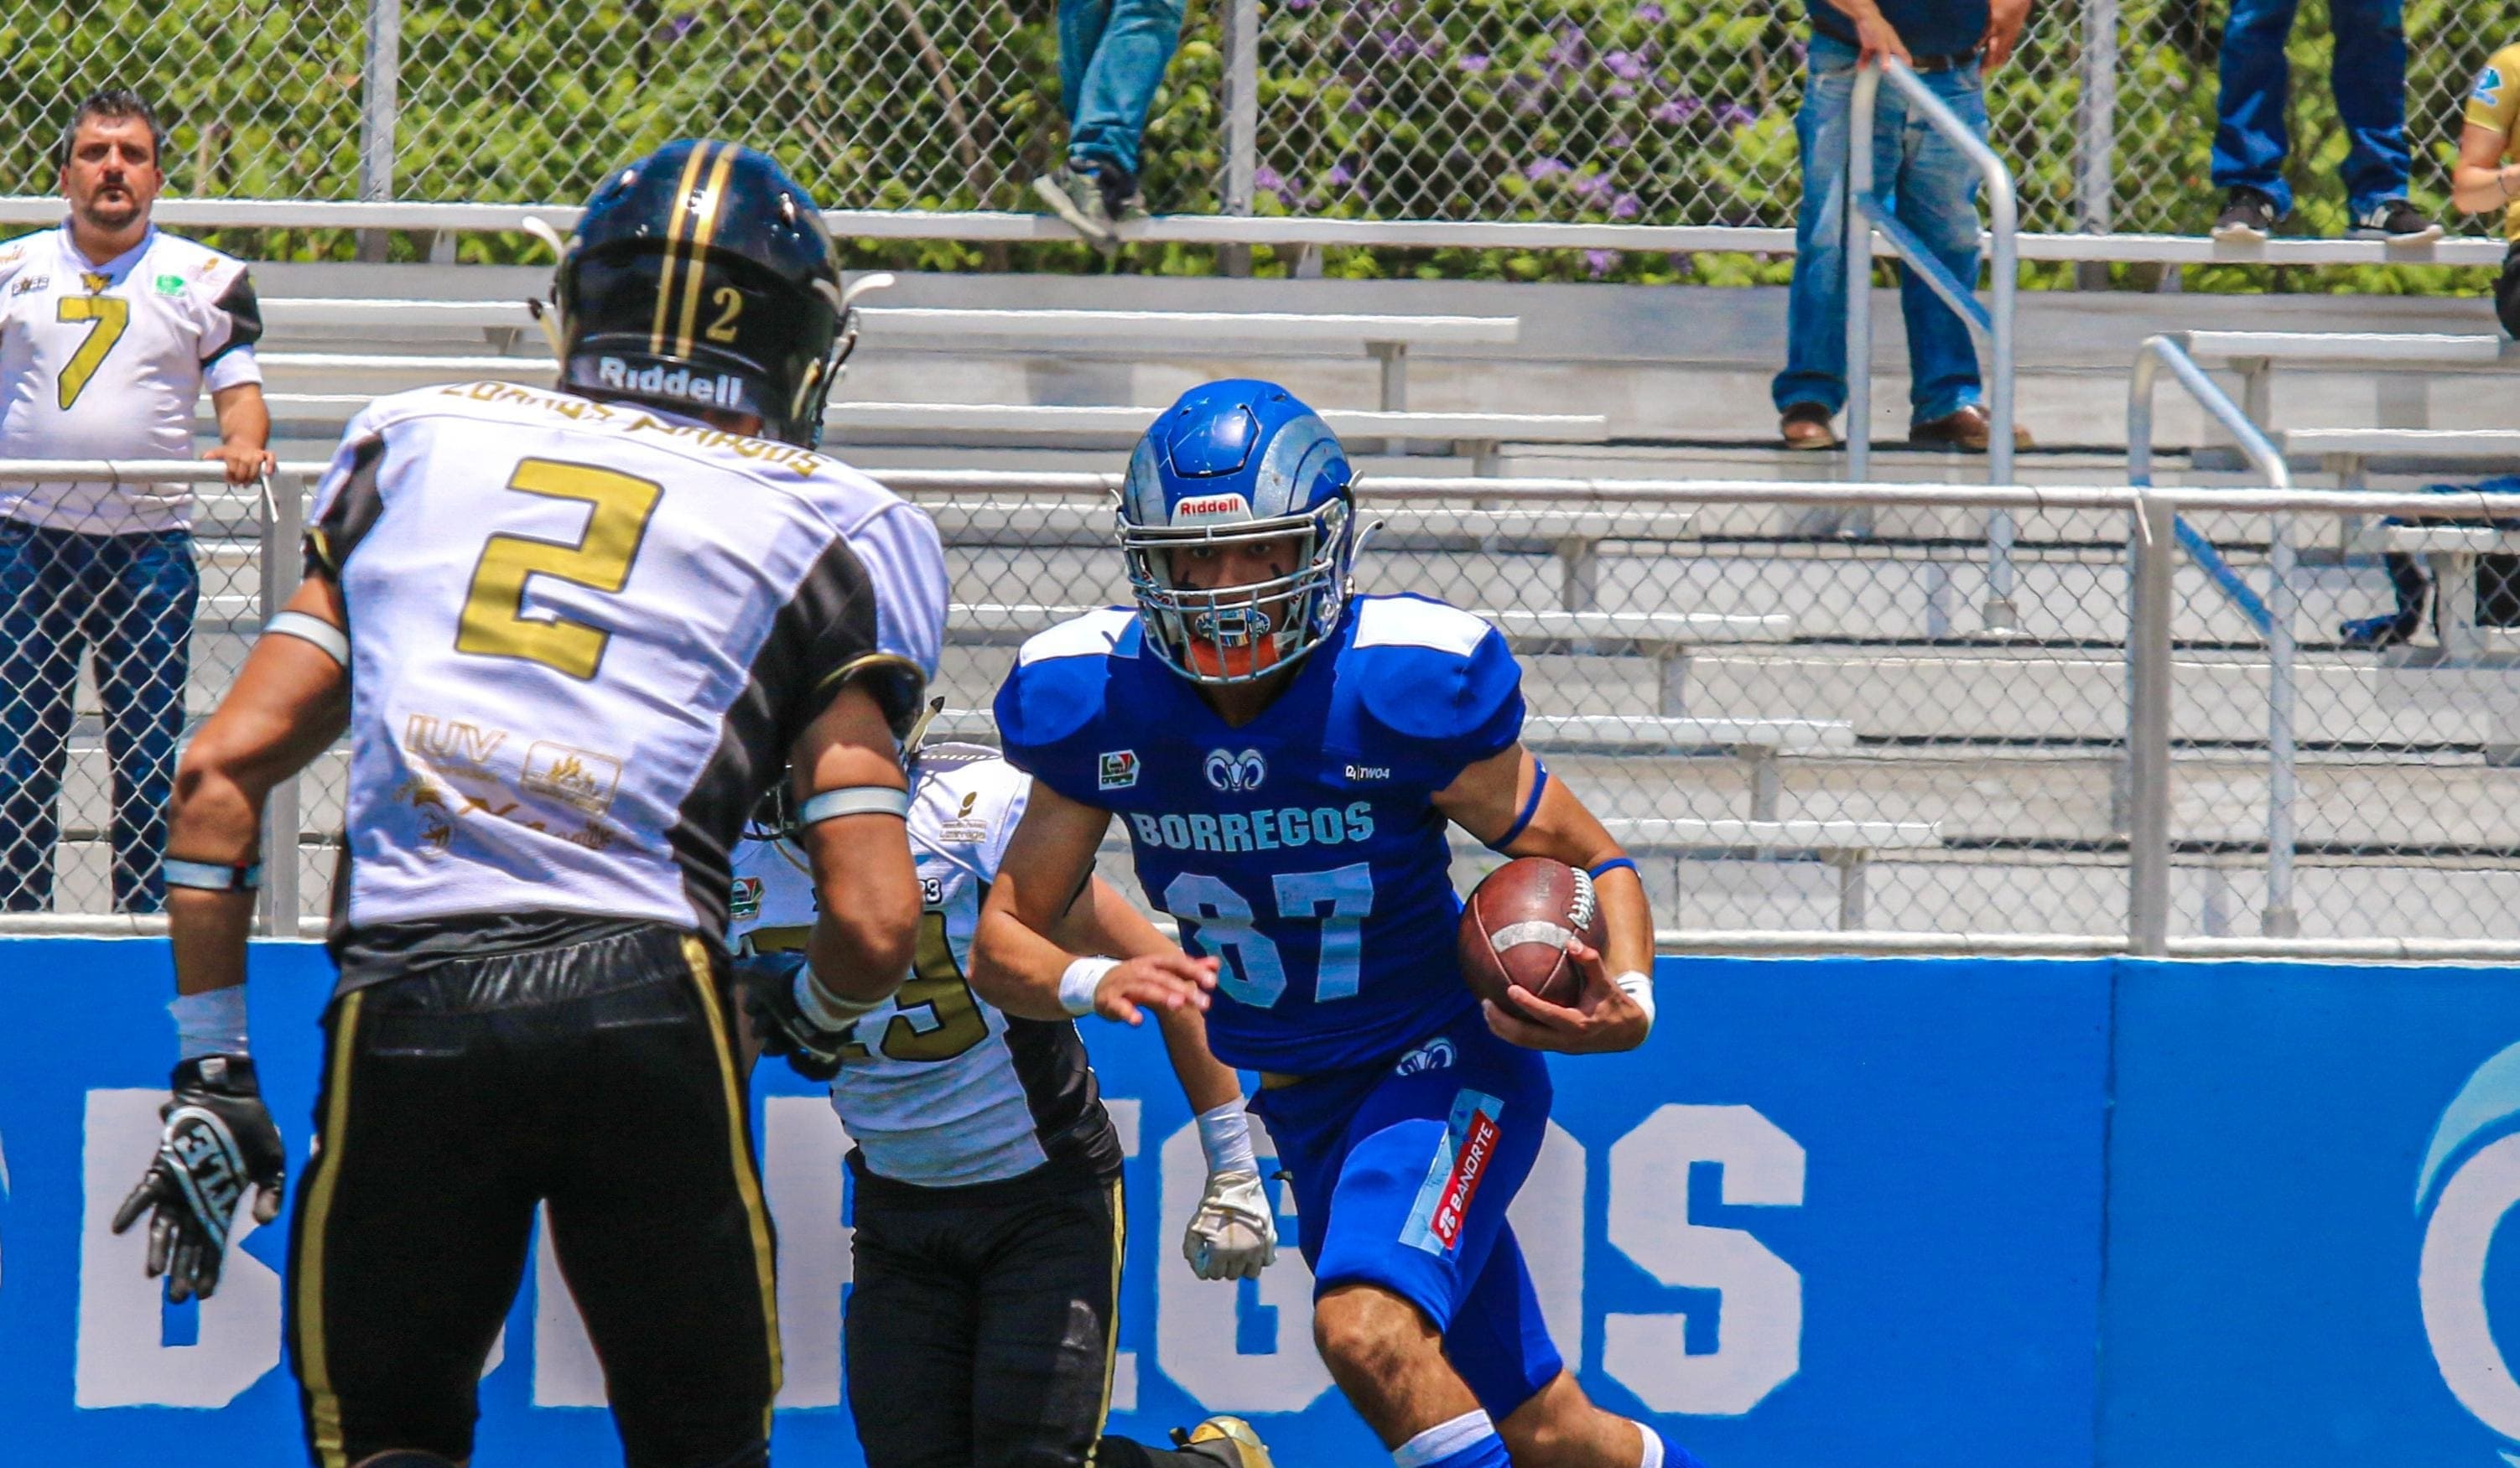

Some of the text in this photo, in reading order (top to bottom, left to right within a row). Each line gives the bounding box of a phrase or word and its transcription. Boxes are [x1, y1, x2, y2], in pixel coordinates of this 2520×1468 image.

[705, 287, 742, 344] 2
[57, 296, 129, 410] 7
[598, 355, 744, 408] Riddell
[1180, 496, 1239, 517] Riddell
[454, 456, 666, 682] 2
[1130, 801, 1375, 852] BORREGOS
[1162, 861, 1375, 1009] 87
[1450, 1121, 1494, 1212] BANORTE
